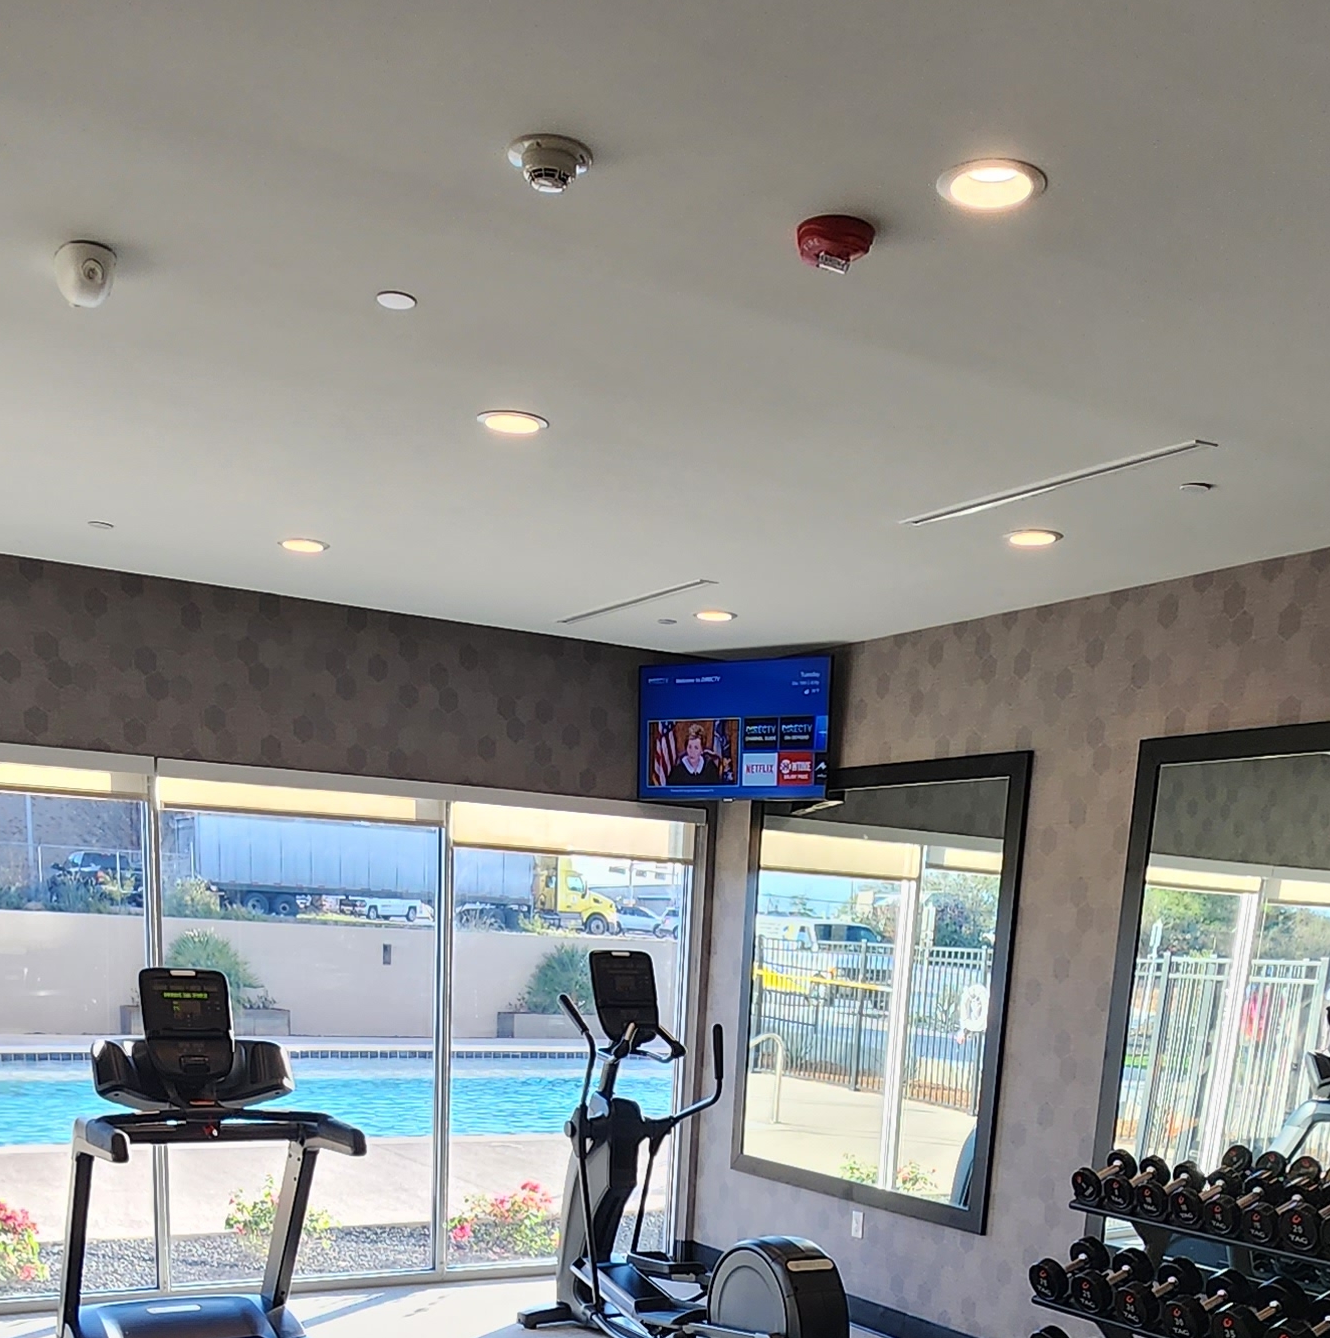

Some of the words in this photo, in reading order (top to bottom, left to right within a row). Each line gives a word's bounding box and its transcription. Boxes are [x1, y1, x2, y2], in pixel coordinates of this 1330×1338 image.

[745, 724, 776, 735] DIRECTV
[781, 723, 813, 734] DIRECTV
[745, 763, 774, 774] NETFLIX
[1211, 1220, 1227, 1230] TAG
[1250, 1229, 1266, 1238] TAG
[1288, 1234, 1309, 1245] TAG
[1036, 1284, 1052, 1296] TAG
[1079, 1298, 1096, 1308] TAG
[1122, 1311, 1140, 1323] TAG
[1172, 1327, 1190, 1337] TAG
